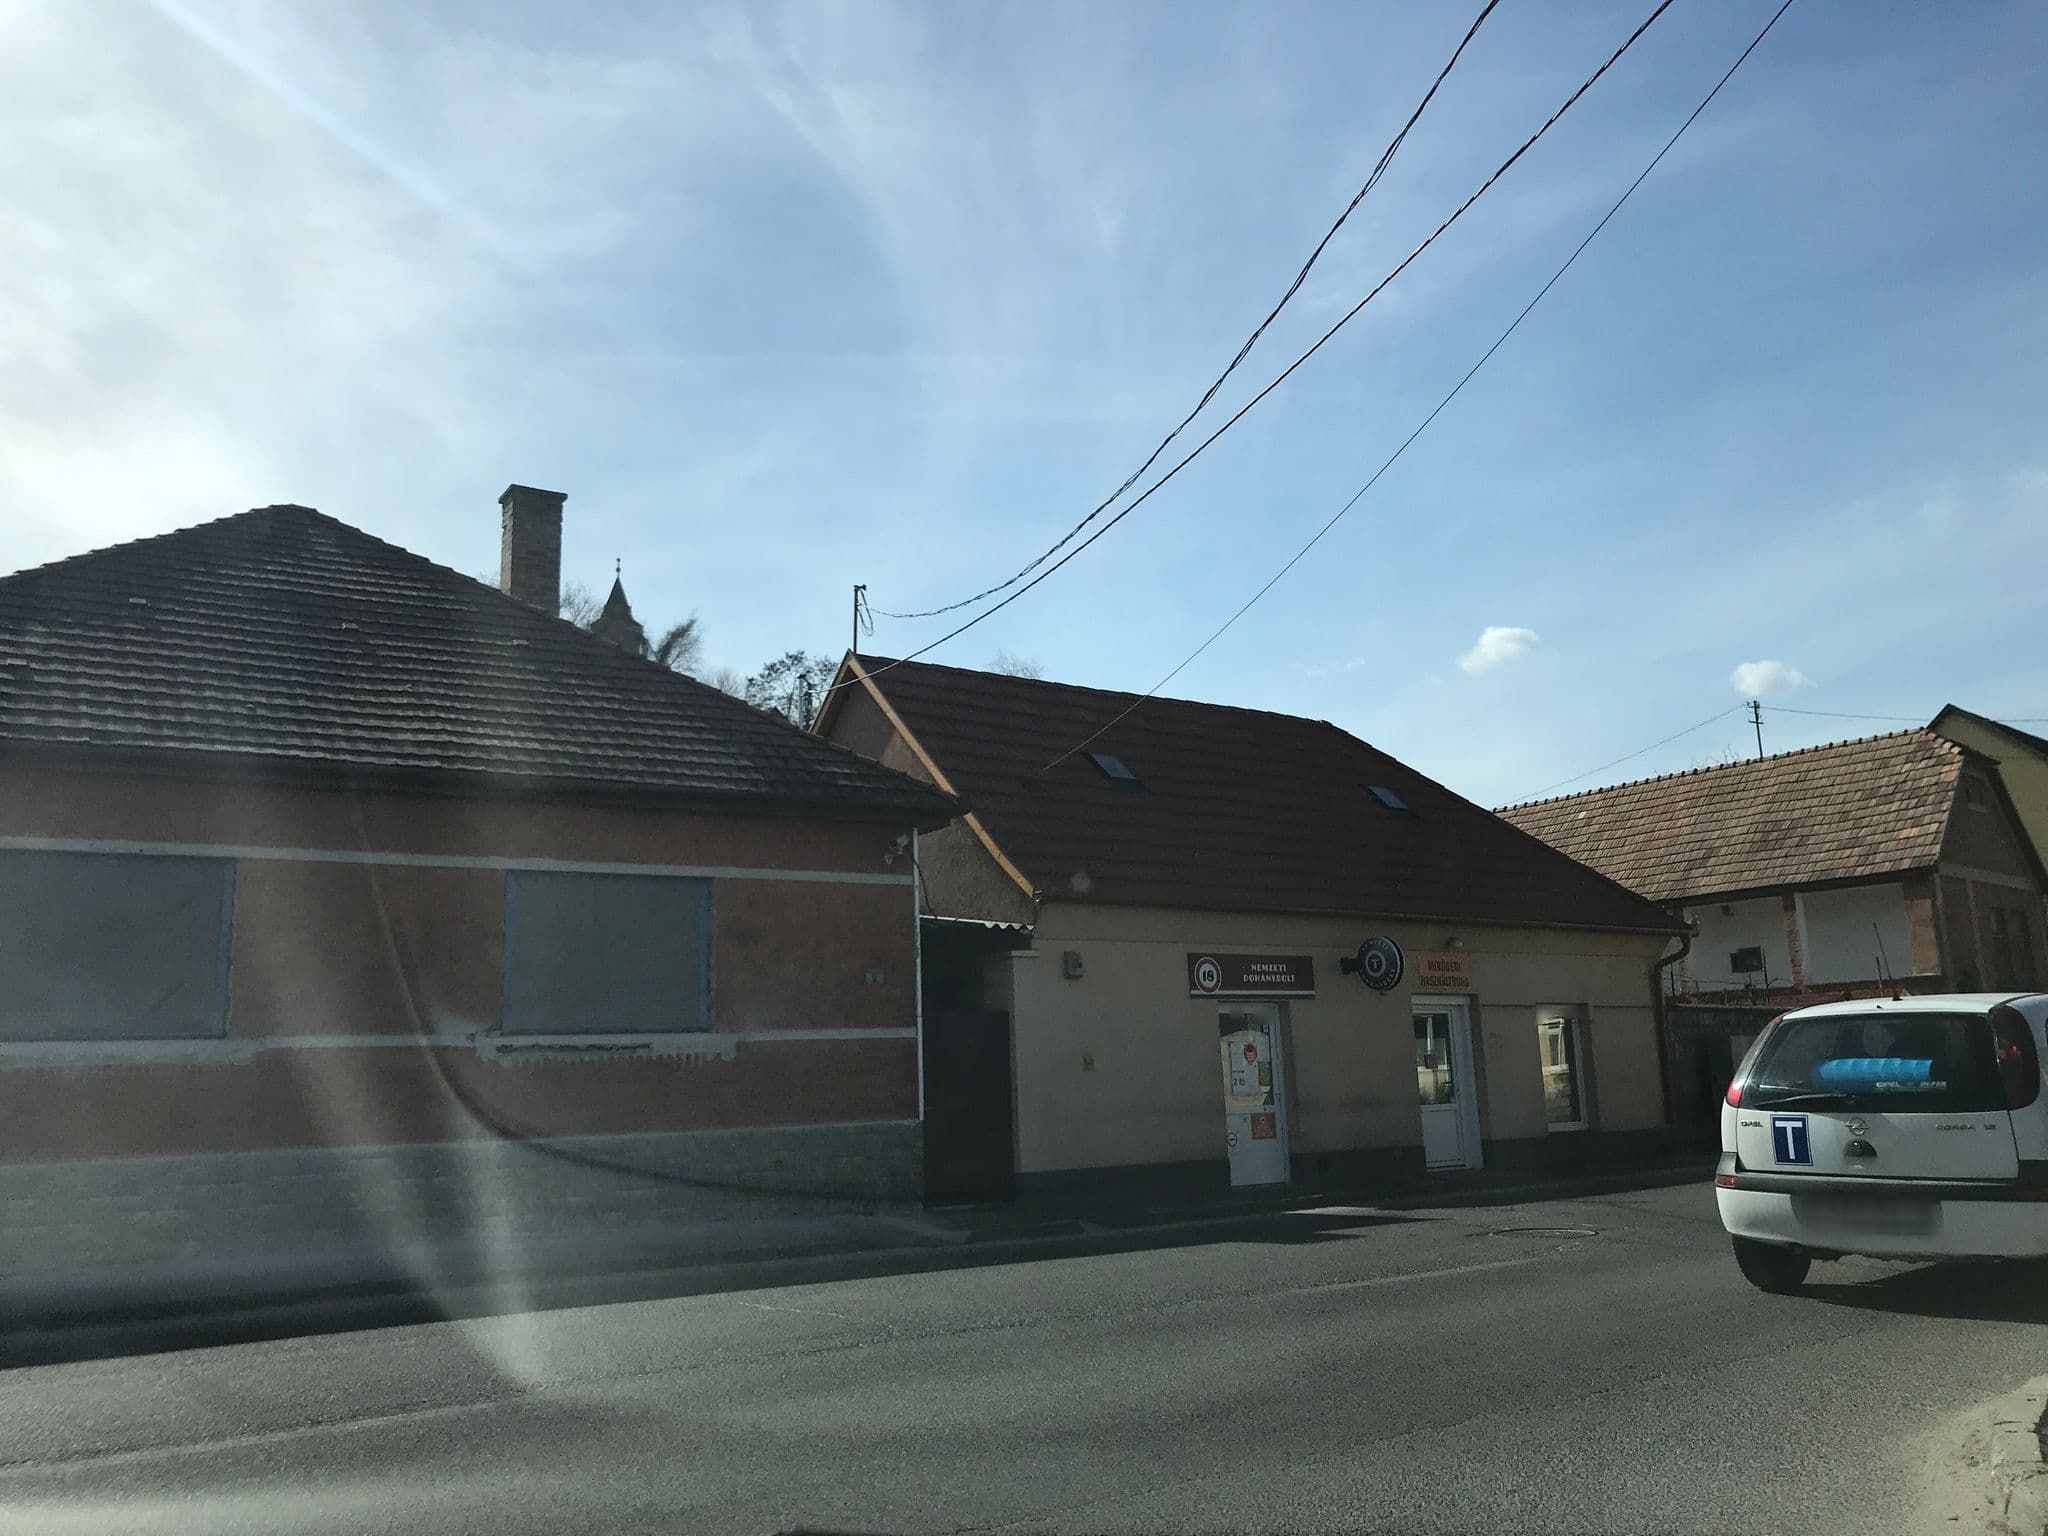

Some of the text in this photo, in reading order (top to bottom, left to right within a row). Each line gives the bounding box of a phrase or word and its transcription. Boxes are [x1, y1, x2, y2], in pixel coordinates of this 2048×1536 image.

[1251, 963, 1287, 972] NEMZETI
[1202, 969, 1215, 982] 18
[1775, 1120, 1803, 1160] T
